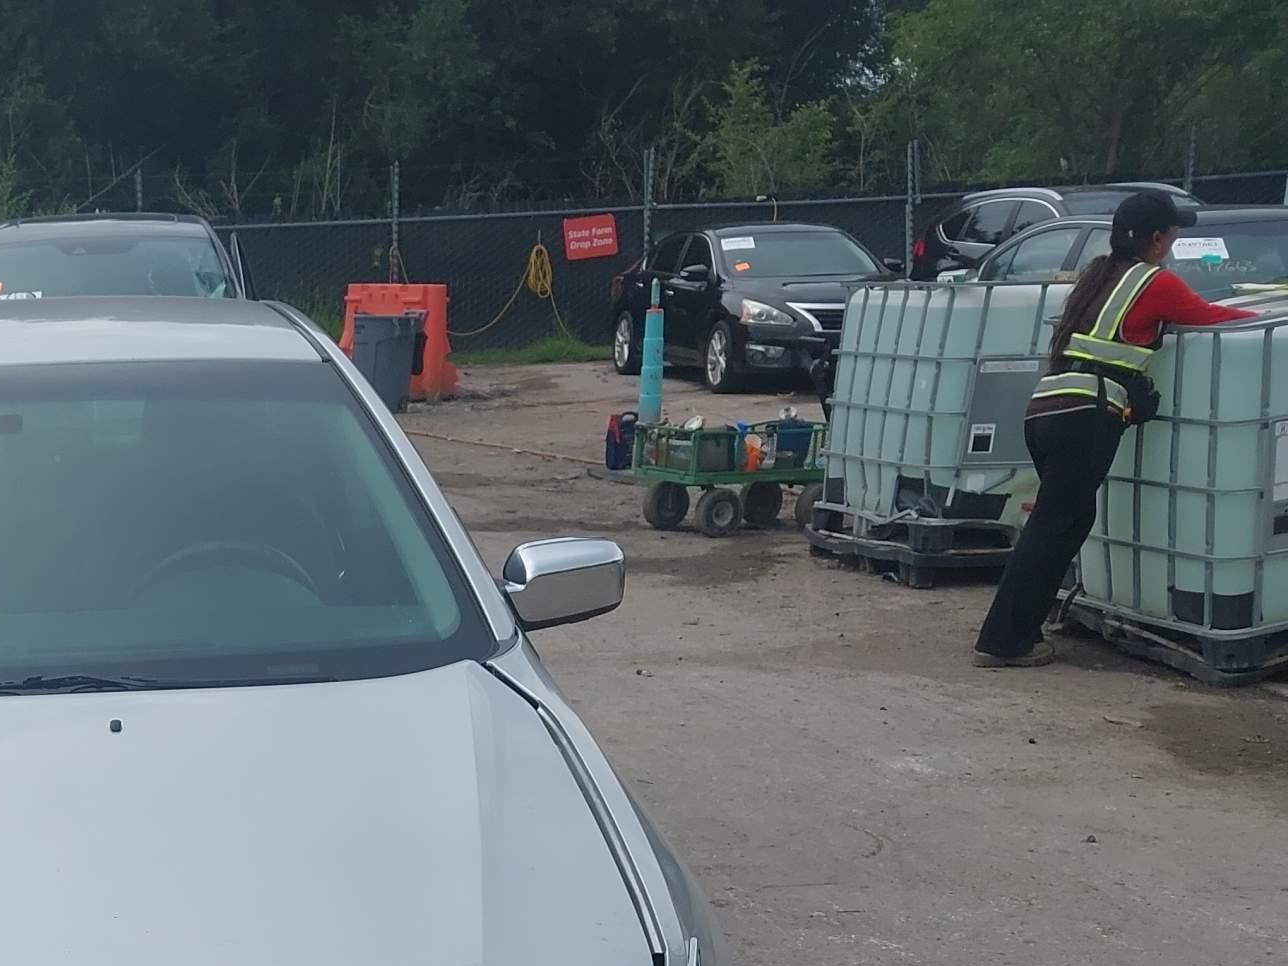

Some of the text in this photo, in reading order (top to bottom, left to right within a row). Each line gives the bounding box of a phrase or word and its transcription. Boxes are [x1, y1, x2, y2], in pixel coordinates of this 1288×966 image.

[568, 226, 613, 239] State Farm
[570, 237, 613, 249] Drop Zone
